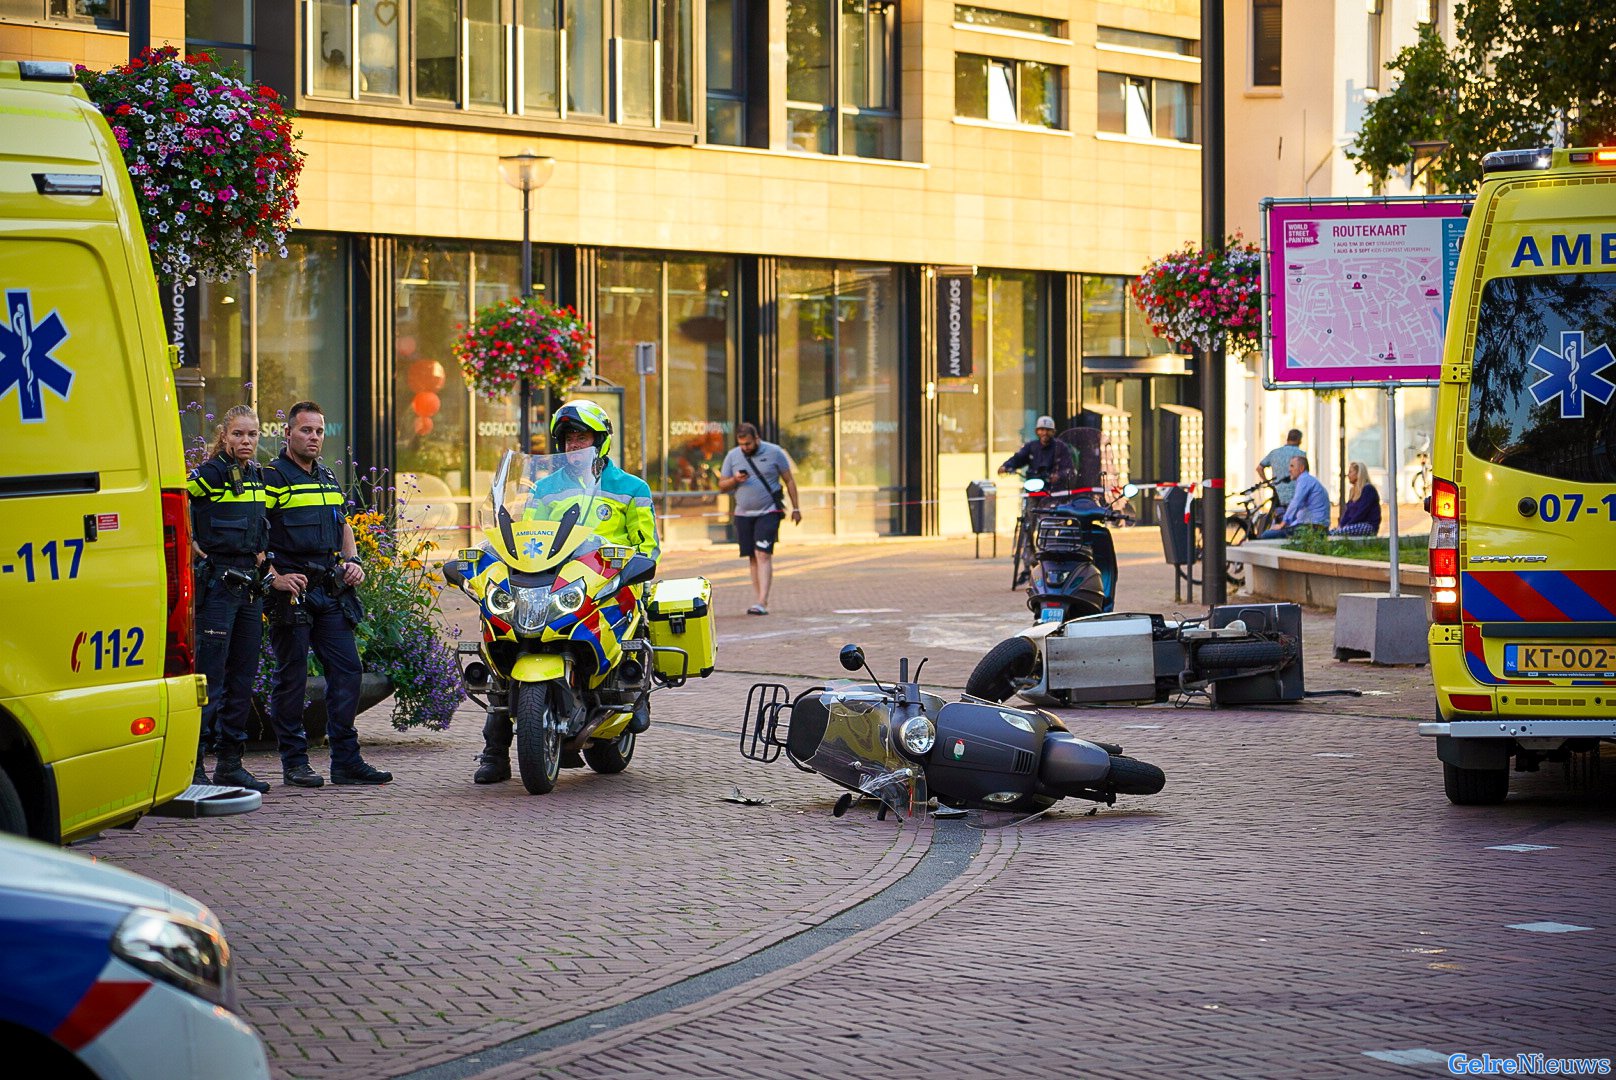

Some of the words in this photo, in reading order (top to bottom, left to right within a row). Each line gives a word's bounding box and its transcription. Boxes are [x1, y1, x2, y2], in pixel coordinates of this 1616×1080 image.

[1333, 225, 1407, 238] ROUTEKAART
[1511, 233, 1616, 268] AMB
[949, 279, 961, 376] SOFACOMPANY
[1539, 494, 1616, 522] 07-1
[2, 538, 84, 582] -117
[1469, 555, 1548, 564] SPRINTER
[90, 627, 145, 671] 1-1-2
[1506, 660, 1516, 668] NL
